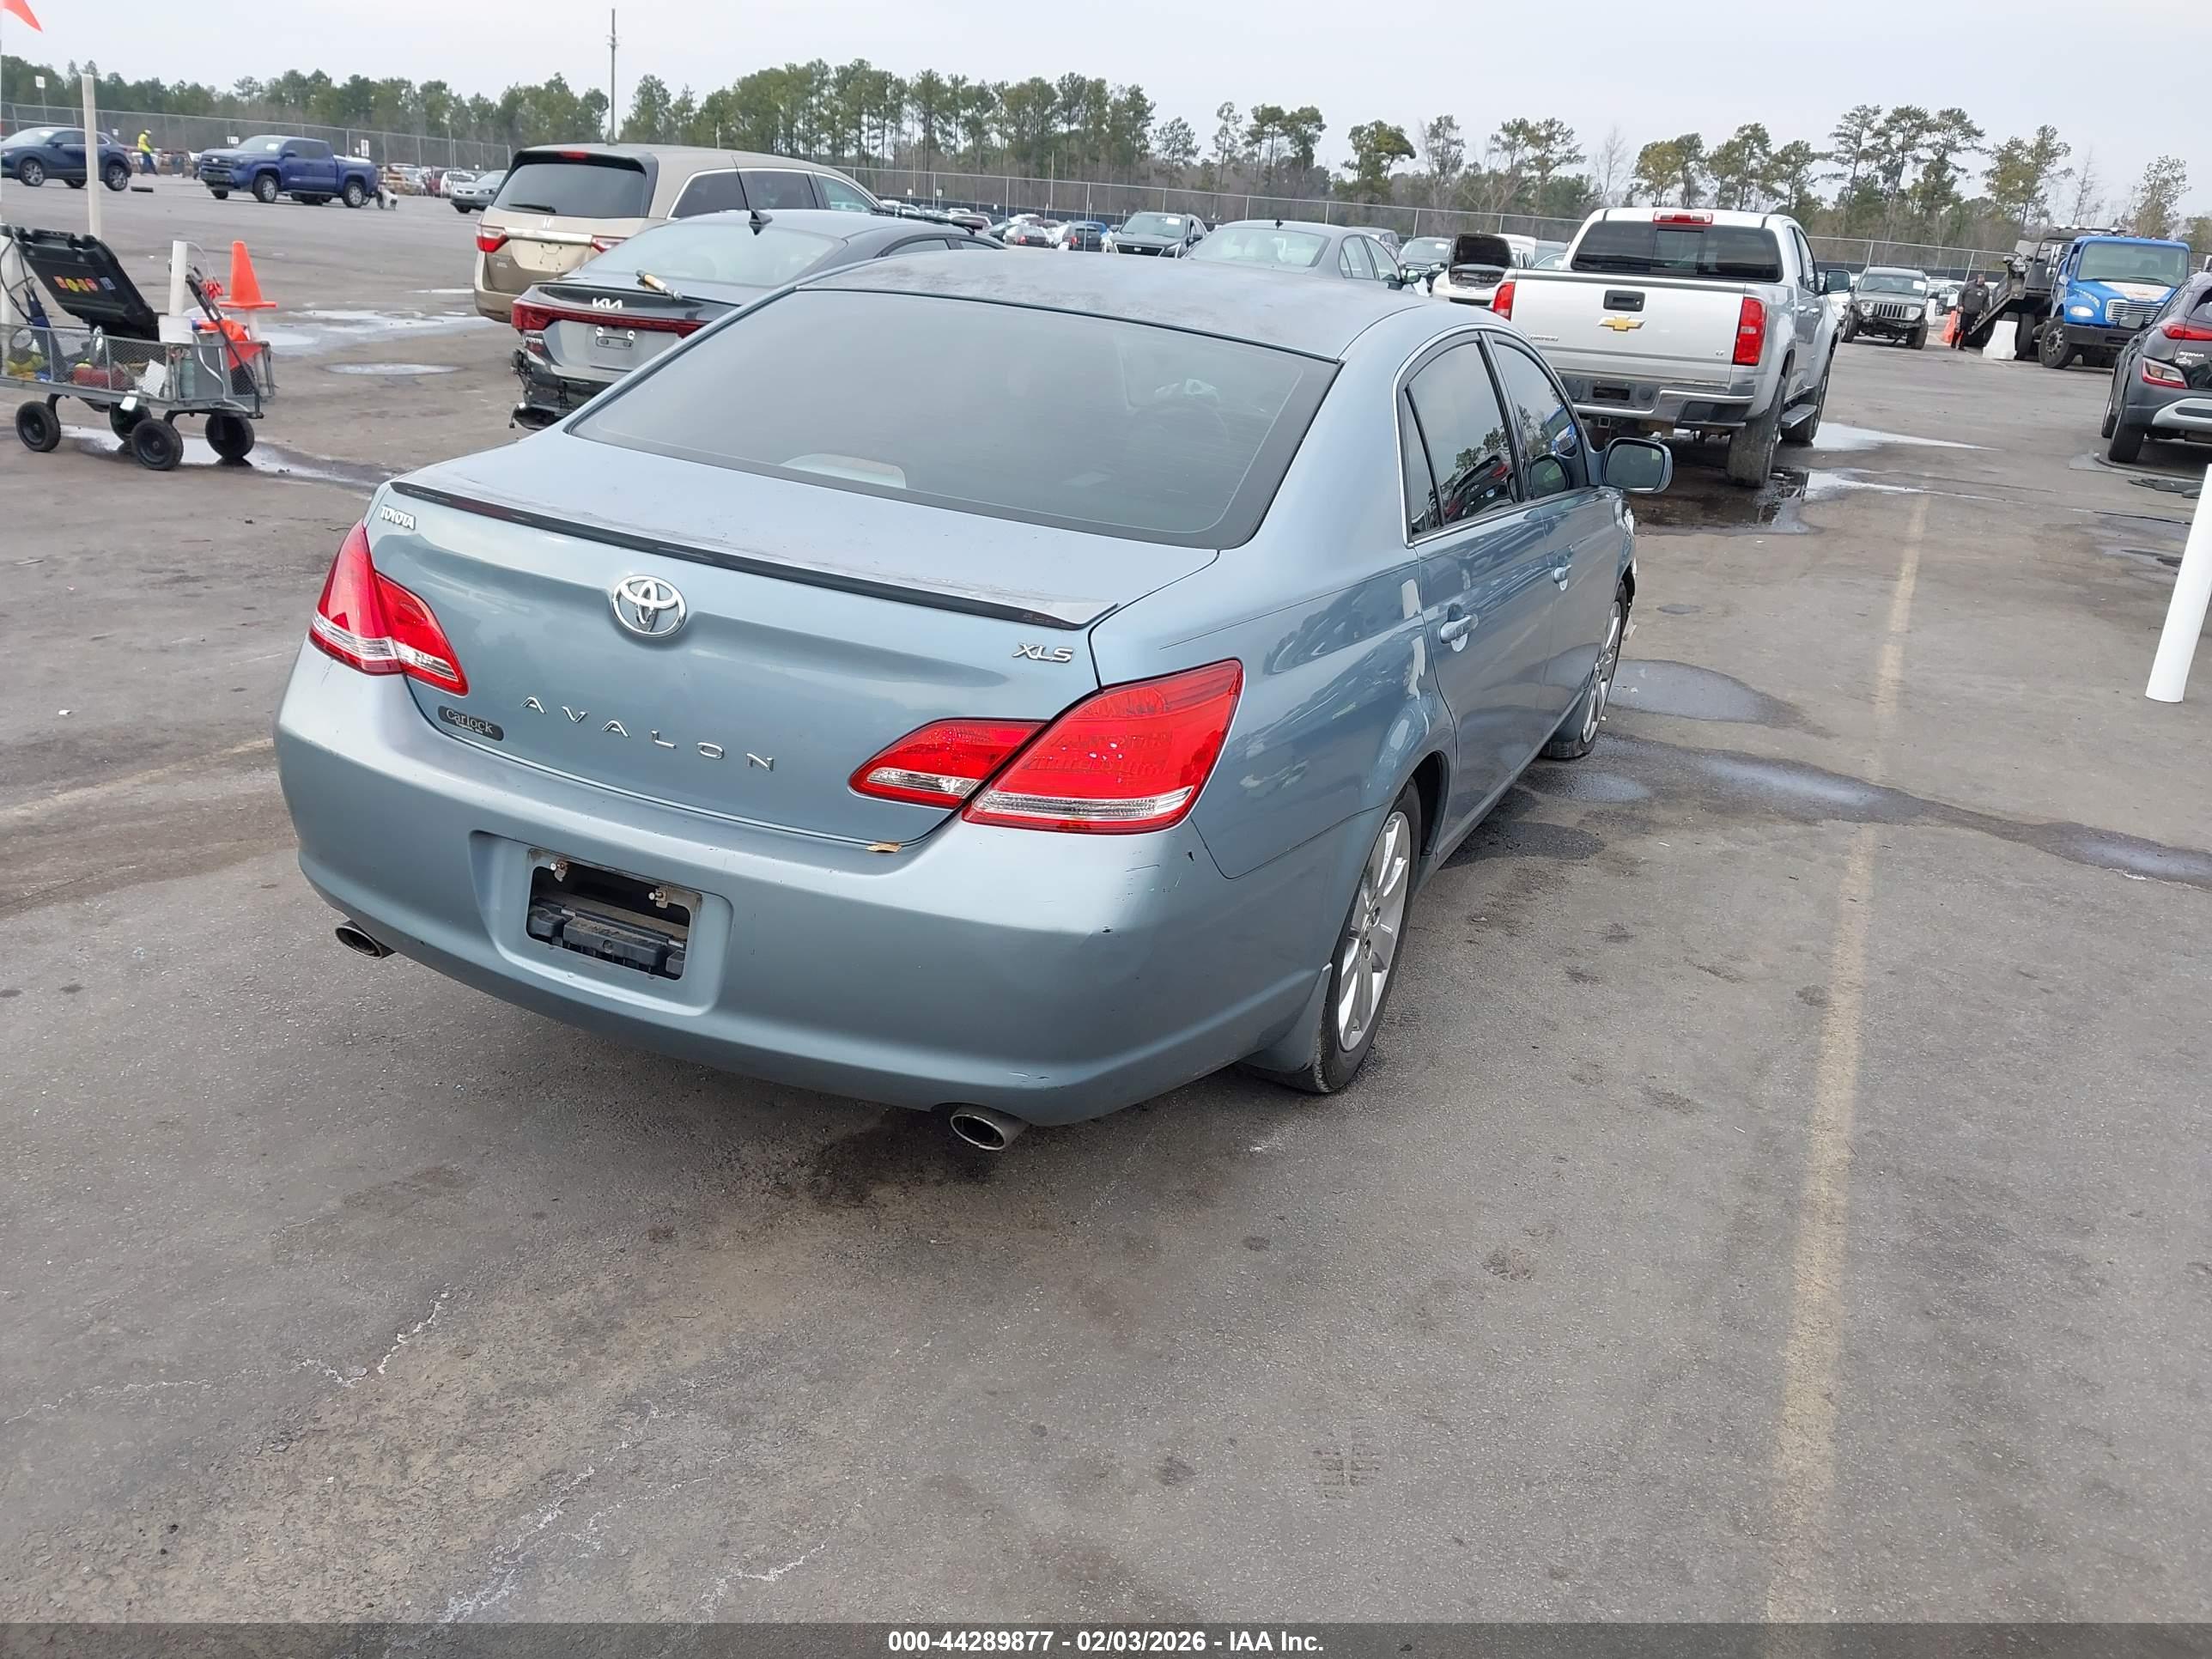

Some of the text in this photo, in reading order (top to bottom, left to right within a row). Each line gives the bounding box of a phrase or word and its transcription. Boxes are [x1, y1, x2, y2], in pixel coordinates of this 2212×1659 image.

[380, 505, 416, 531] TOYOTA
[1012, 642, 1074, 663] XLS
[446, 708, 494, 734] Carlock
[520, 696, 775, 771] AVALON
